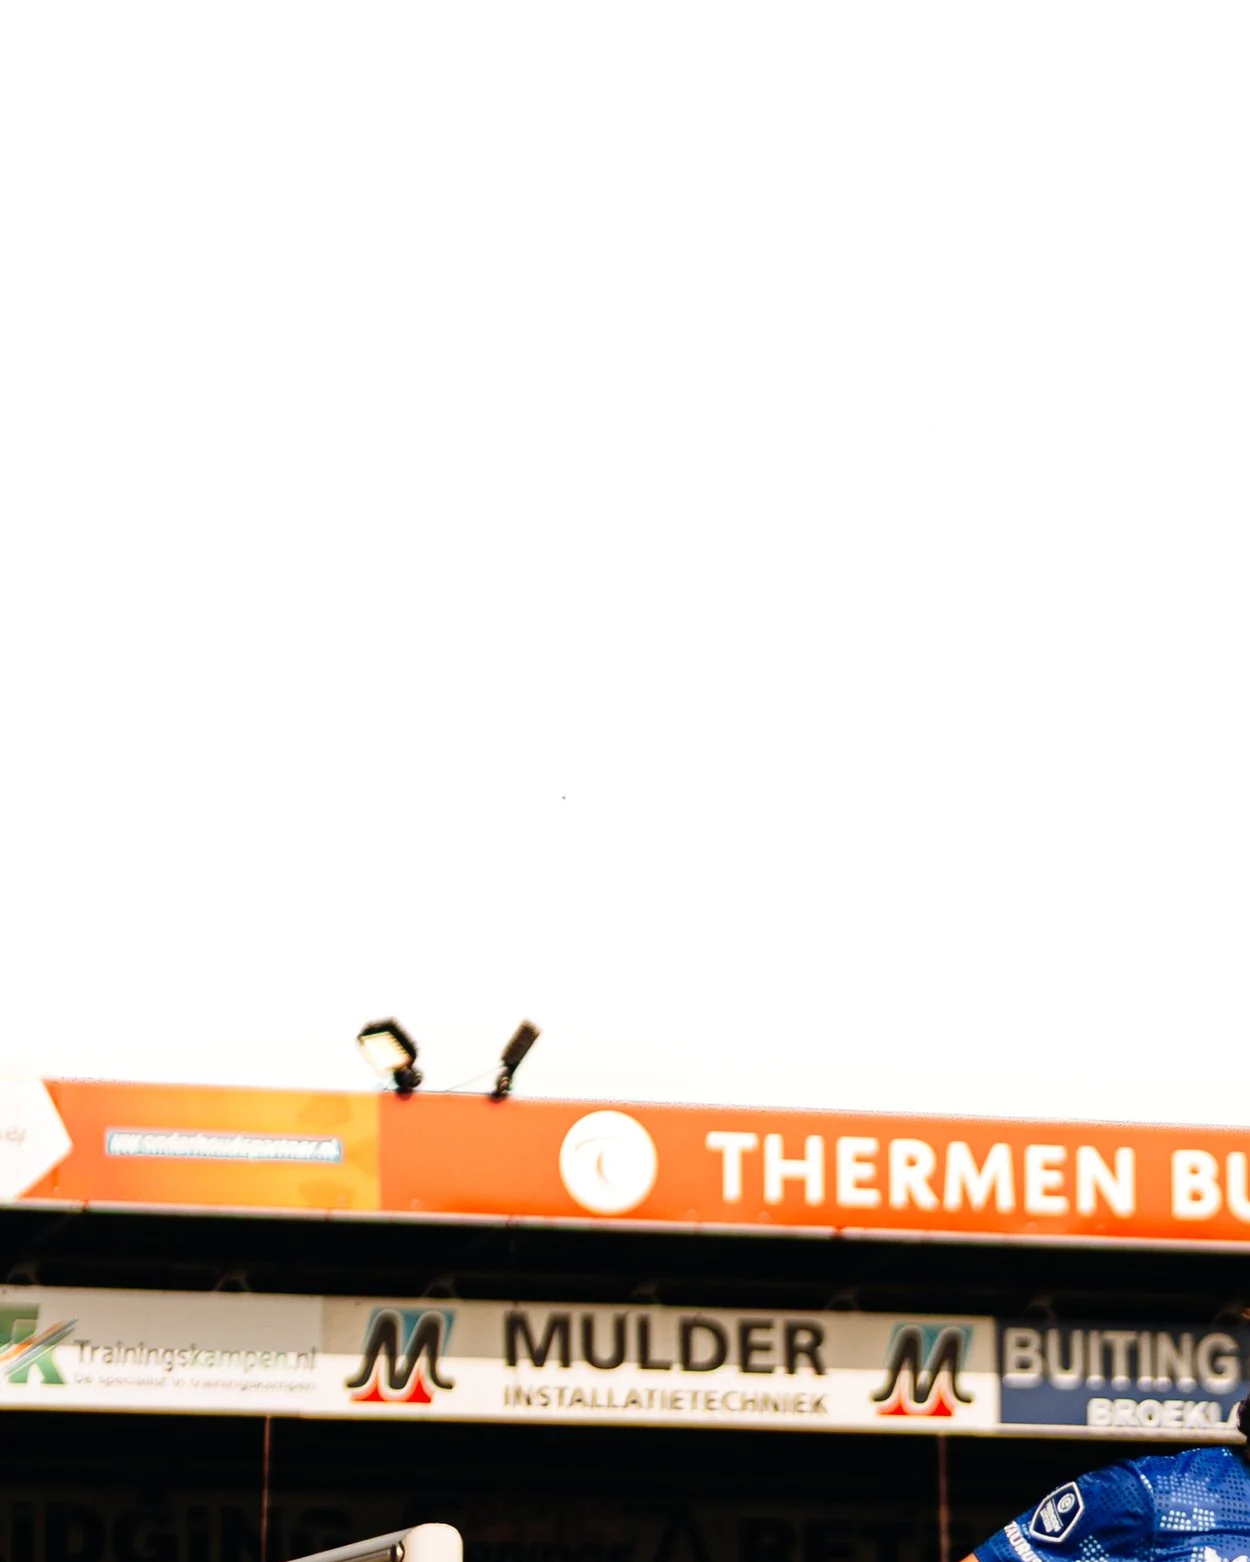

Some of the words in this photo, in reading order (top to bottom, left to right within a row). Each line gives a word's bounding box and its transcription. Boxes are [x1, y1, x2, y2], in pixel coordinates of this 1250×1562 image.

[704, 1129, 1137, 1218] THERMEN
[73, 1339, 318, 1374] Trainingskampen.nl
[503, 1309, 827, 1377] MULDER
[1002, 1326, 1242, 1395] BUITING
[98, 1374, 168, 1390] specialist
[502, 1384, 829, 1415] INSTALLATIETECHNIEK
